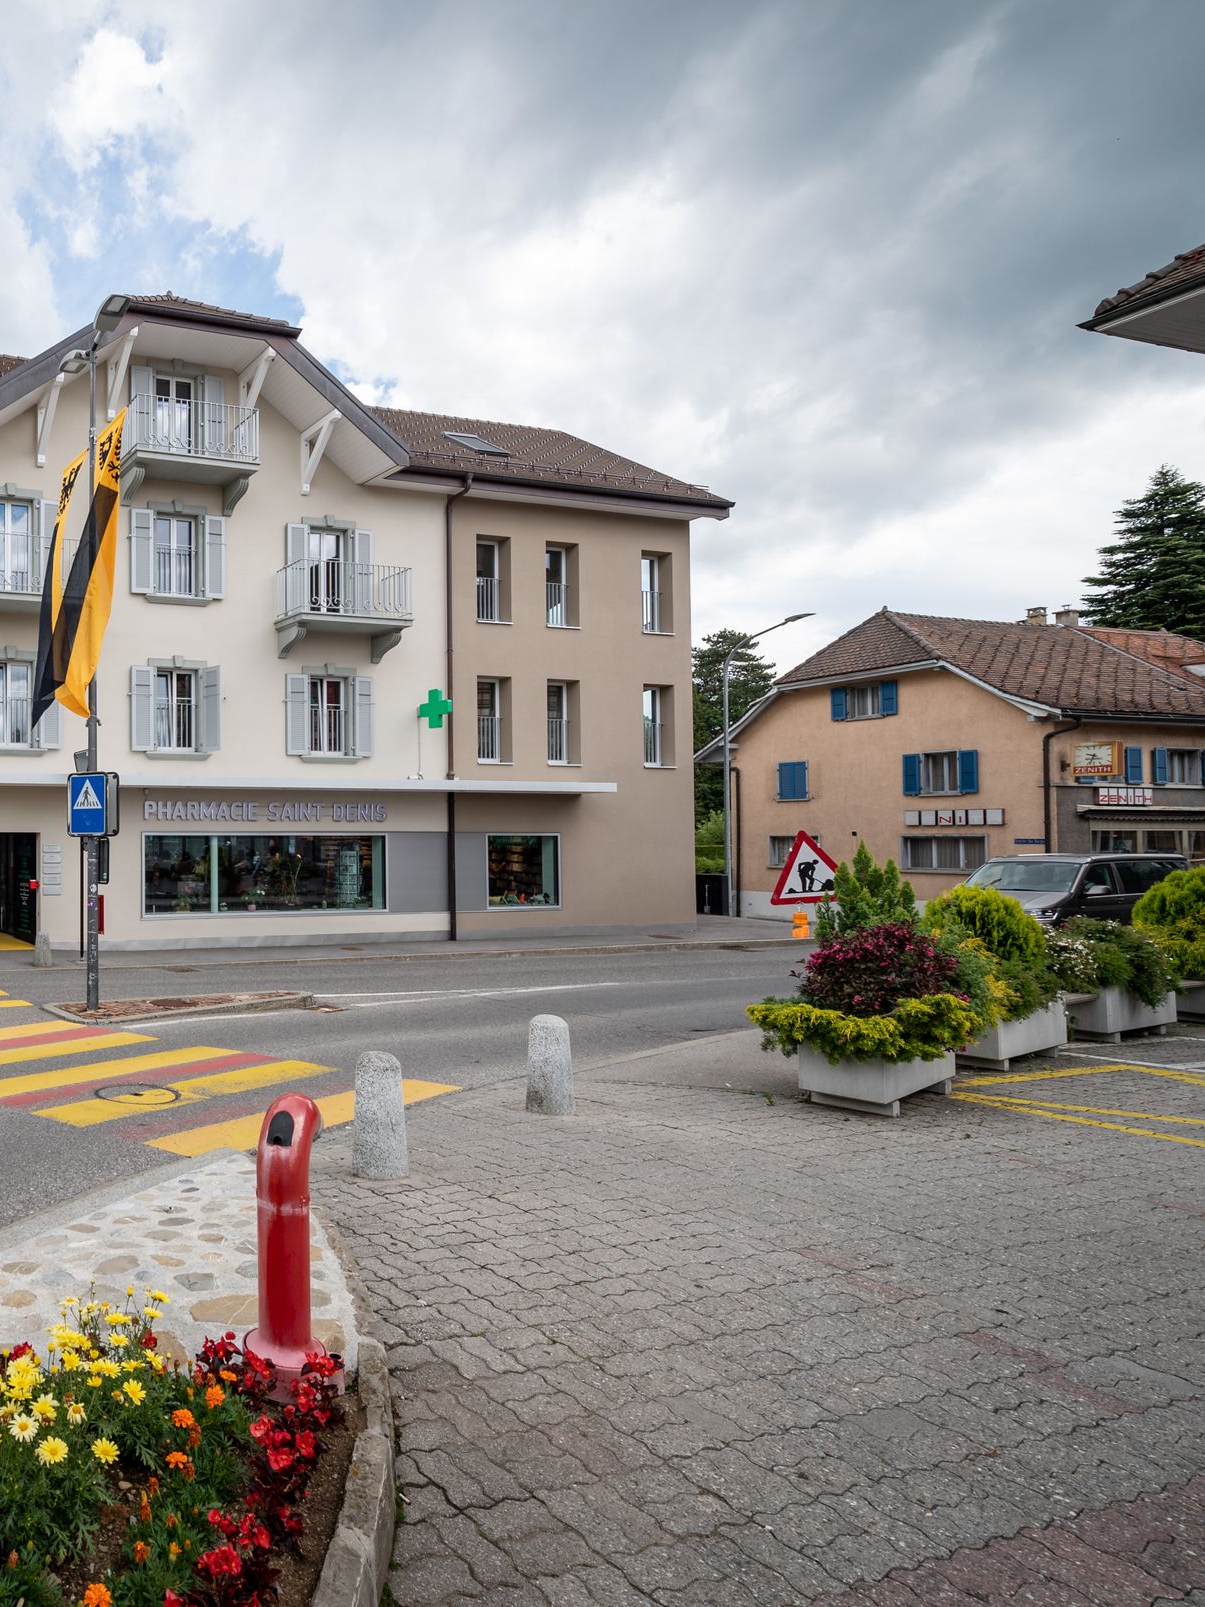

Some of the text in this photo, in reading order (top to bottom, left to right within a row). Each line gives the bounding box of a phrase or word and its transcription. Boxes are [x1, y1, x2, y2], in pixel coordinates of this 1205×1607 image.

[1099, 794, 1153, 803] ZENITH
[144, 800, 387, 823] PHARMACIE SAINT DENIS
